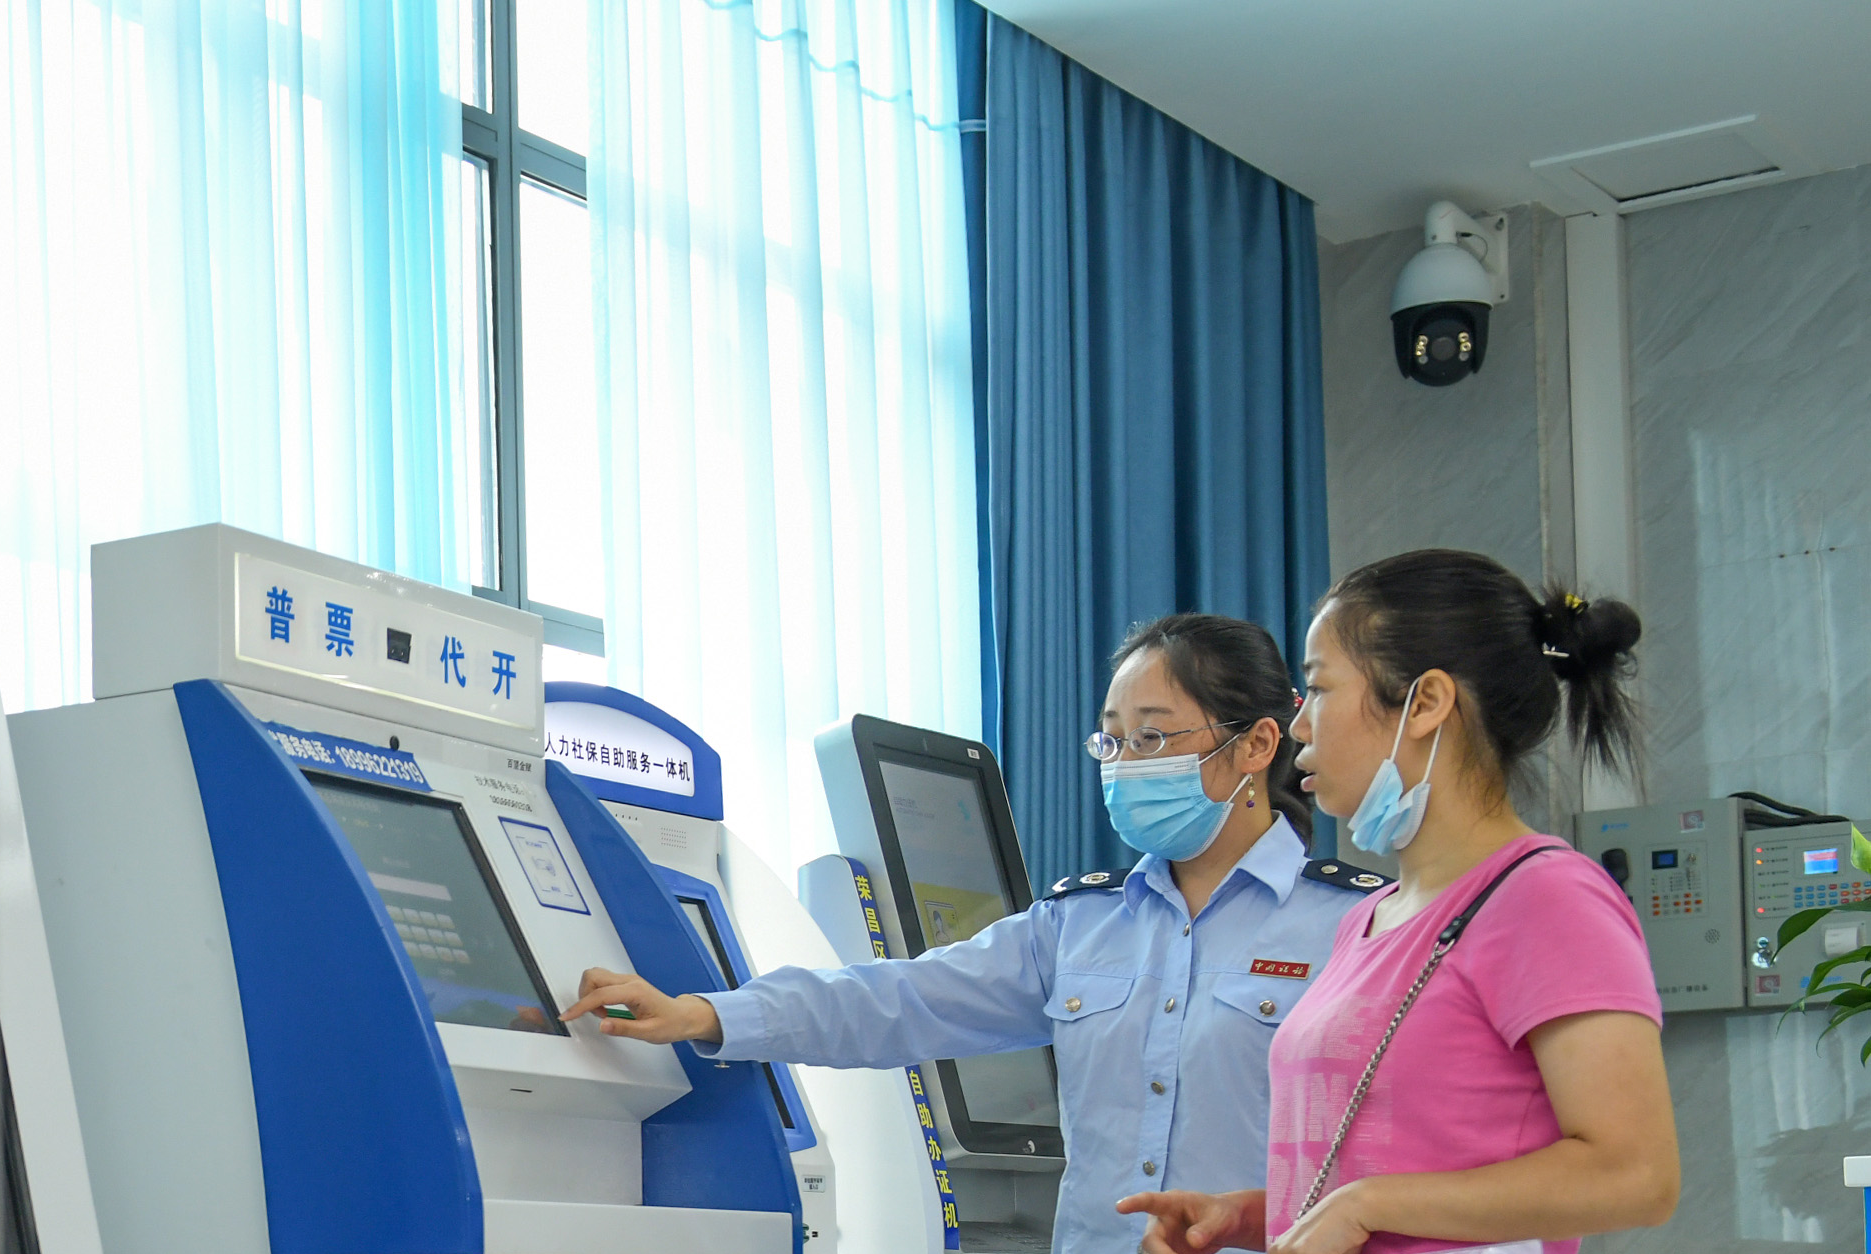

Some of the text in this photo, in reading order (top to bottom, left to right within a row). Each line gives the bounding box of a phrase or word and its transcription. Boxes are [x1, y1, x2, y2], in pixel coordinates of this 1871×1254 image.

[265, 586, 517, 700] 普票代开
[335, 746, 425, 784] 18996221319
[545, 732, 691, 782] 人力社保自助服务一体机
[909, 1070, 958, 1228] 自助办证机
